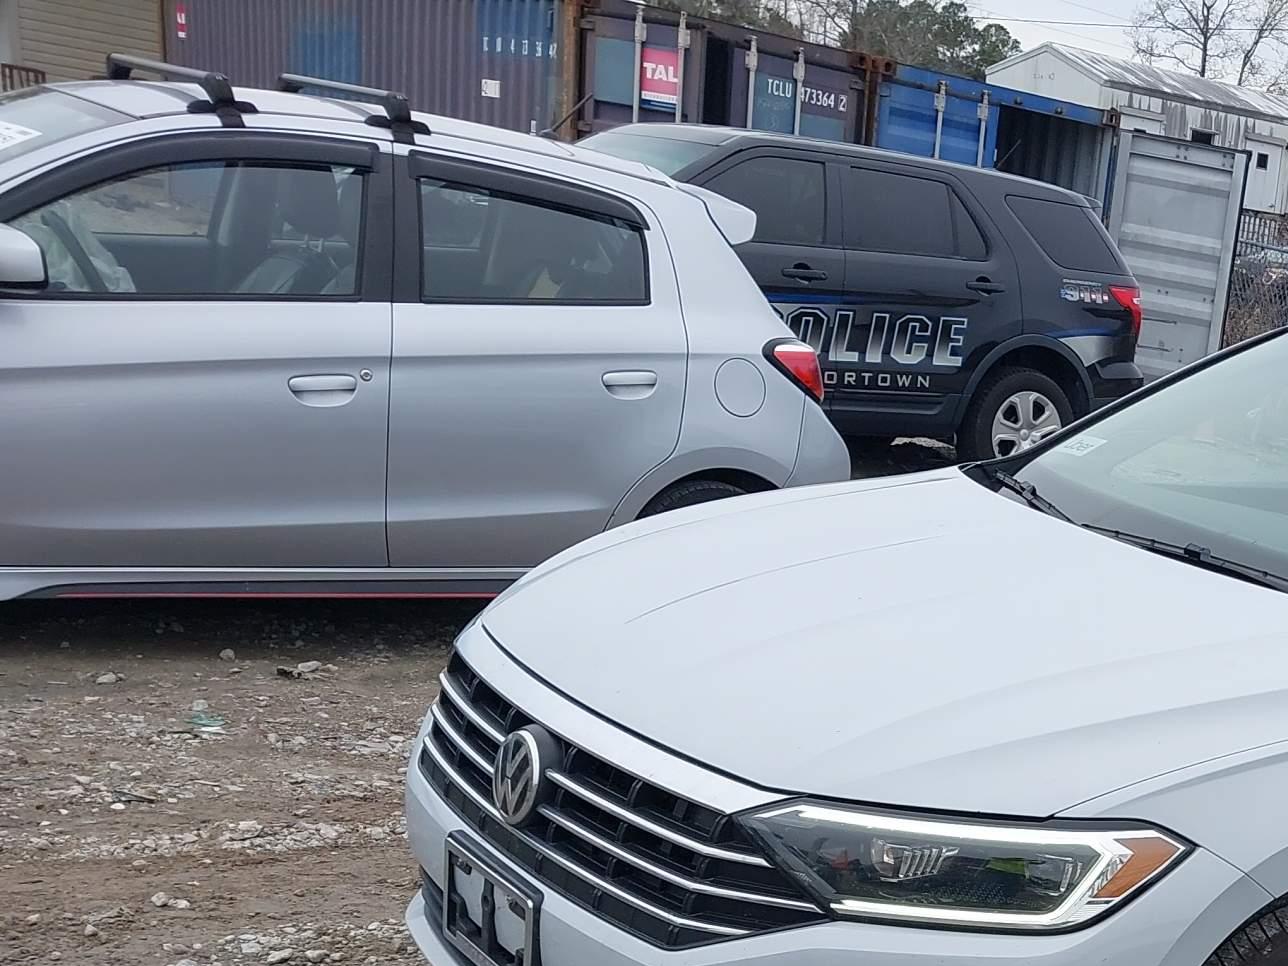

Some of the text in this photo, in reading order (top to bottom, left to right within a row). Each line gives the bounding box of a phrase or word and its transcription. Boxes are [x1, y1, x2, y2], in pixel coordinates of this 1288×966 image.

[643, 62, 678, 82] TAL
[767, 79, 793, 98] TCLU
[771, 304, 968, 367] OLICE
